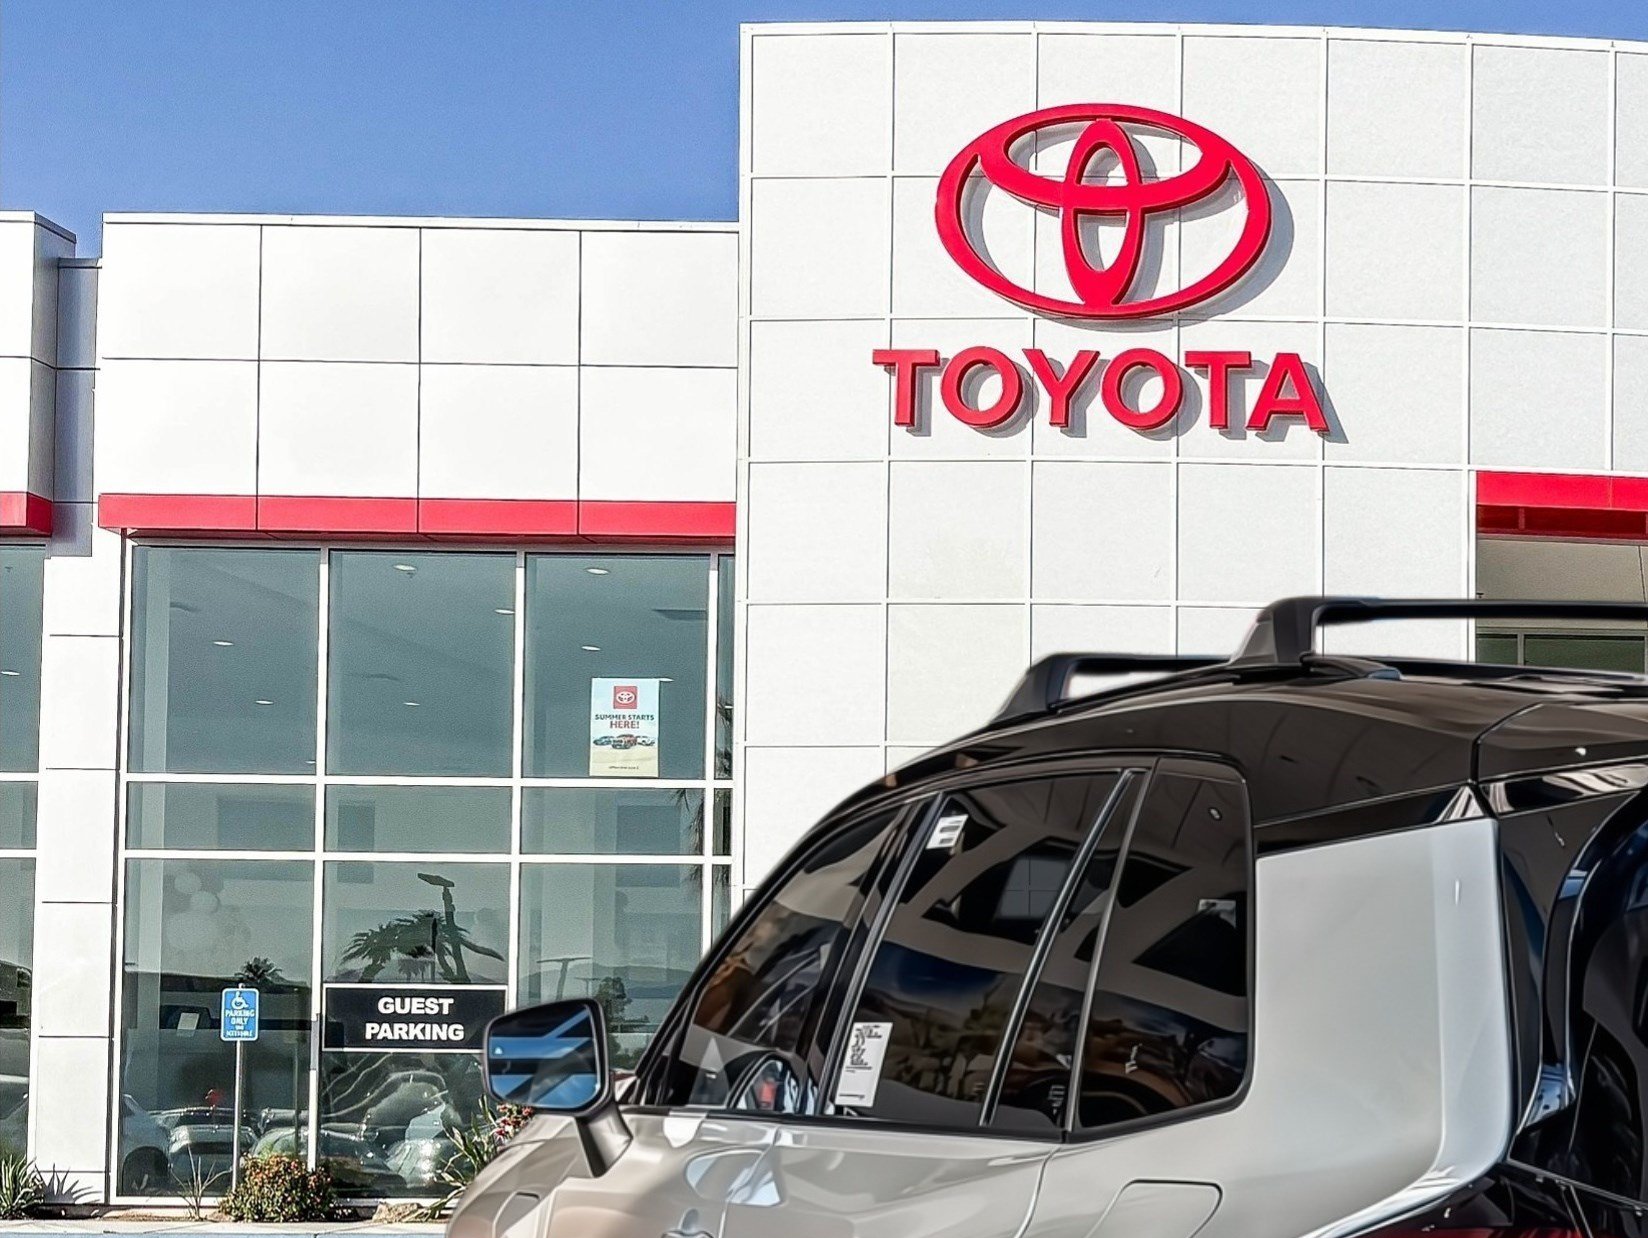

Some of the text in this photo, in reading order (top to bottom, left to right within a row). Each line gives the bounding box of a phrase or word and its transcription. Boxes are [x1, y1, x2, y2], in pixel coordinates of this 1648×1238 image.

[872, 346, 1330, 432] TOYOTA
[609, 720, 640, 729] HERE!
[377, 997, 454, 1015] GUEST
[364, 1022, 465, 1041] PARKING
